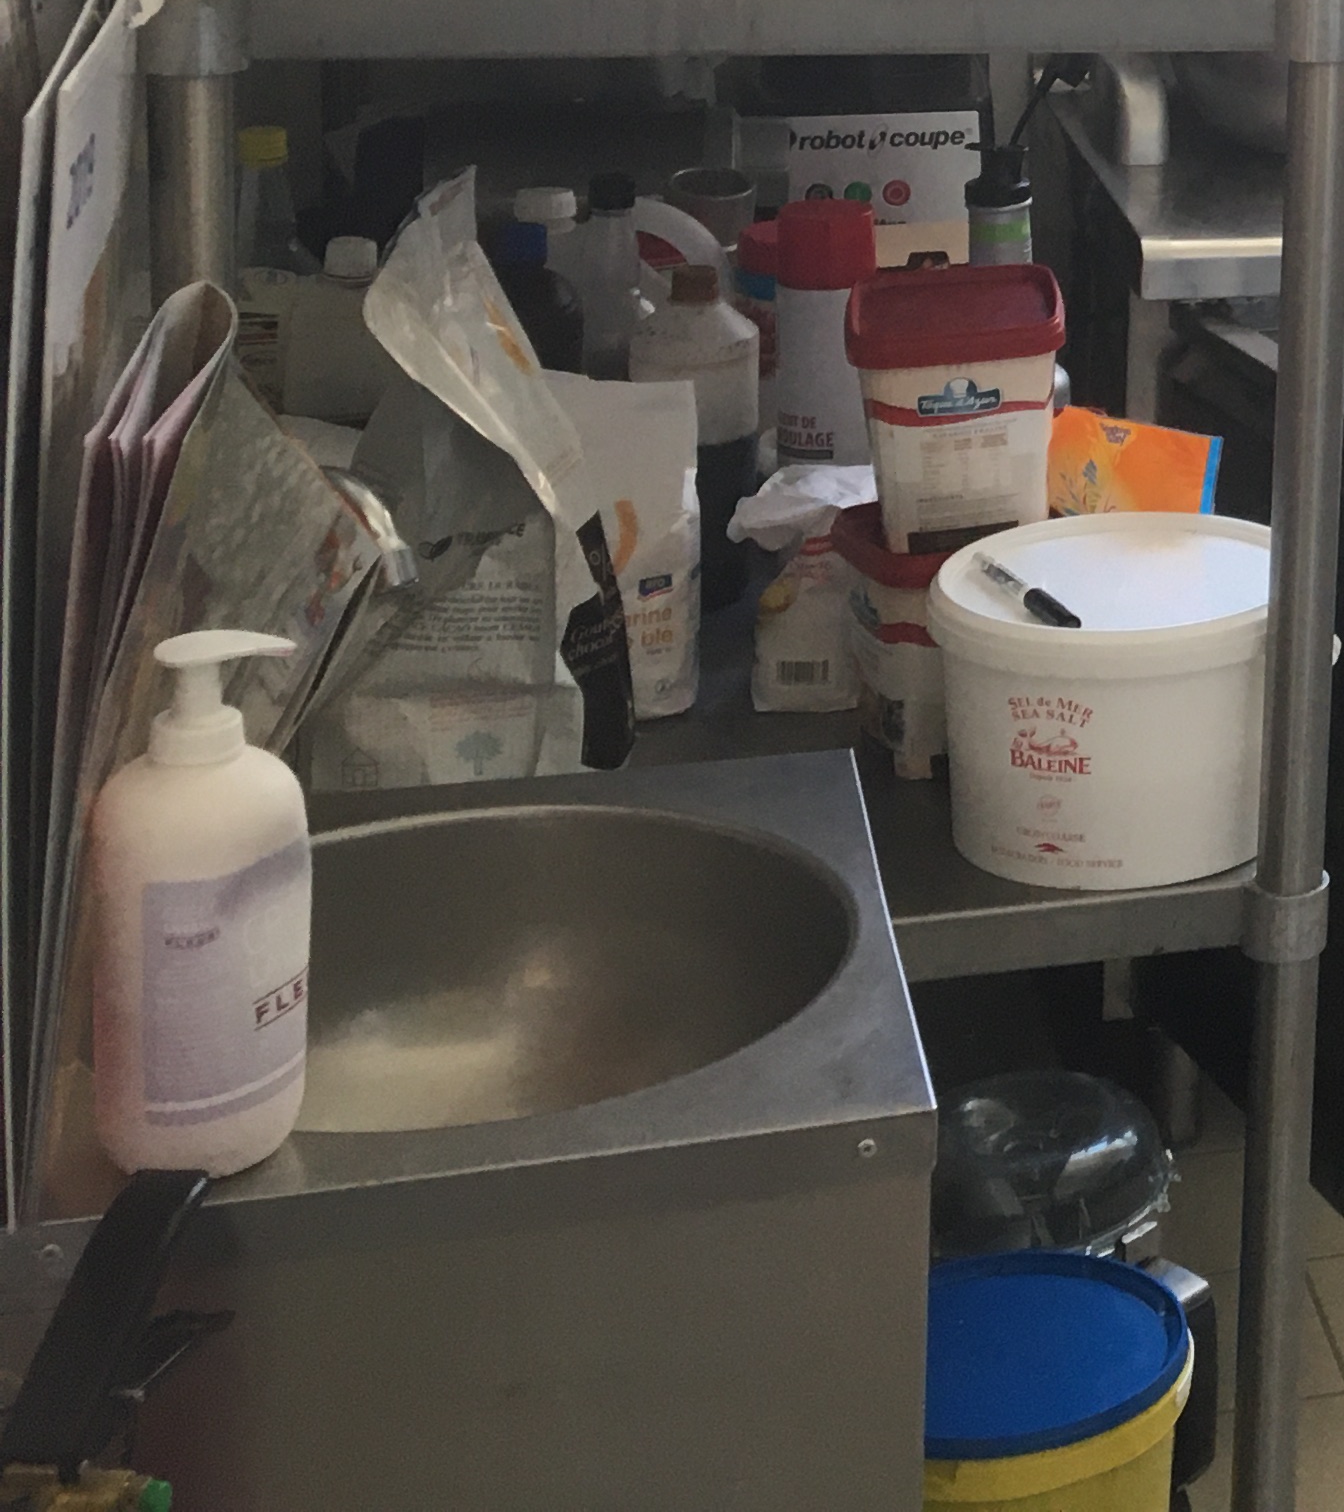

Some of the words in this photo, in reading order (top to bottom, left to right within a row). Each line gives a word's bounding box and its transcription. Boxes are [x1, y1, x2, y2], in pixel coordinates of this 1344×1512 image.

[799, 130, 865, 150] robot
[889, 129, 966, 150] coupe
[802, 416, 816, 429] DE
[1008, 697, 1030, 710] SEL
[1036, 696, 1051, 707] de
[1056, 697, 1093, 719] MER
[1011, 708, 1040, 722] SEA
[1046, 709, 1089, 728] SALT
[1010, 748, 1092, 775] BALEINE
